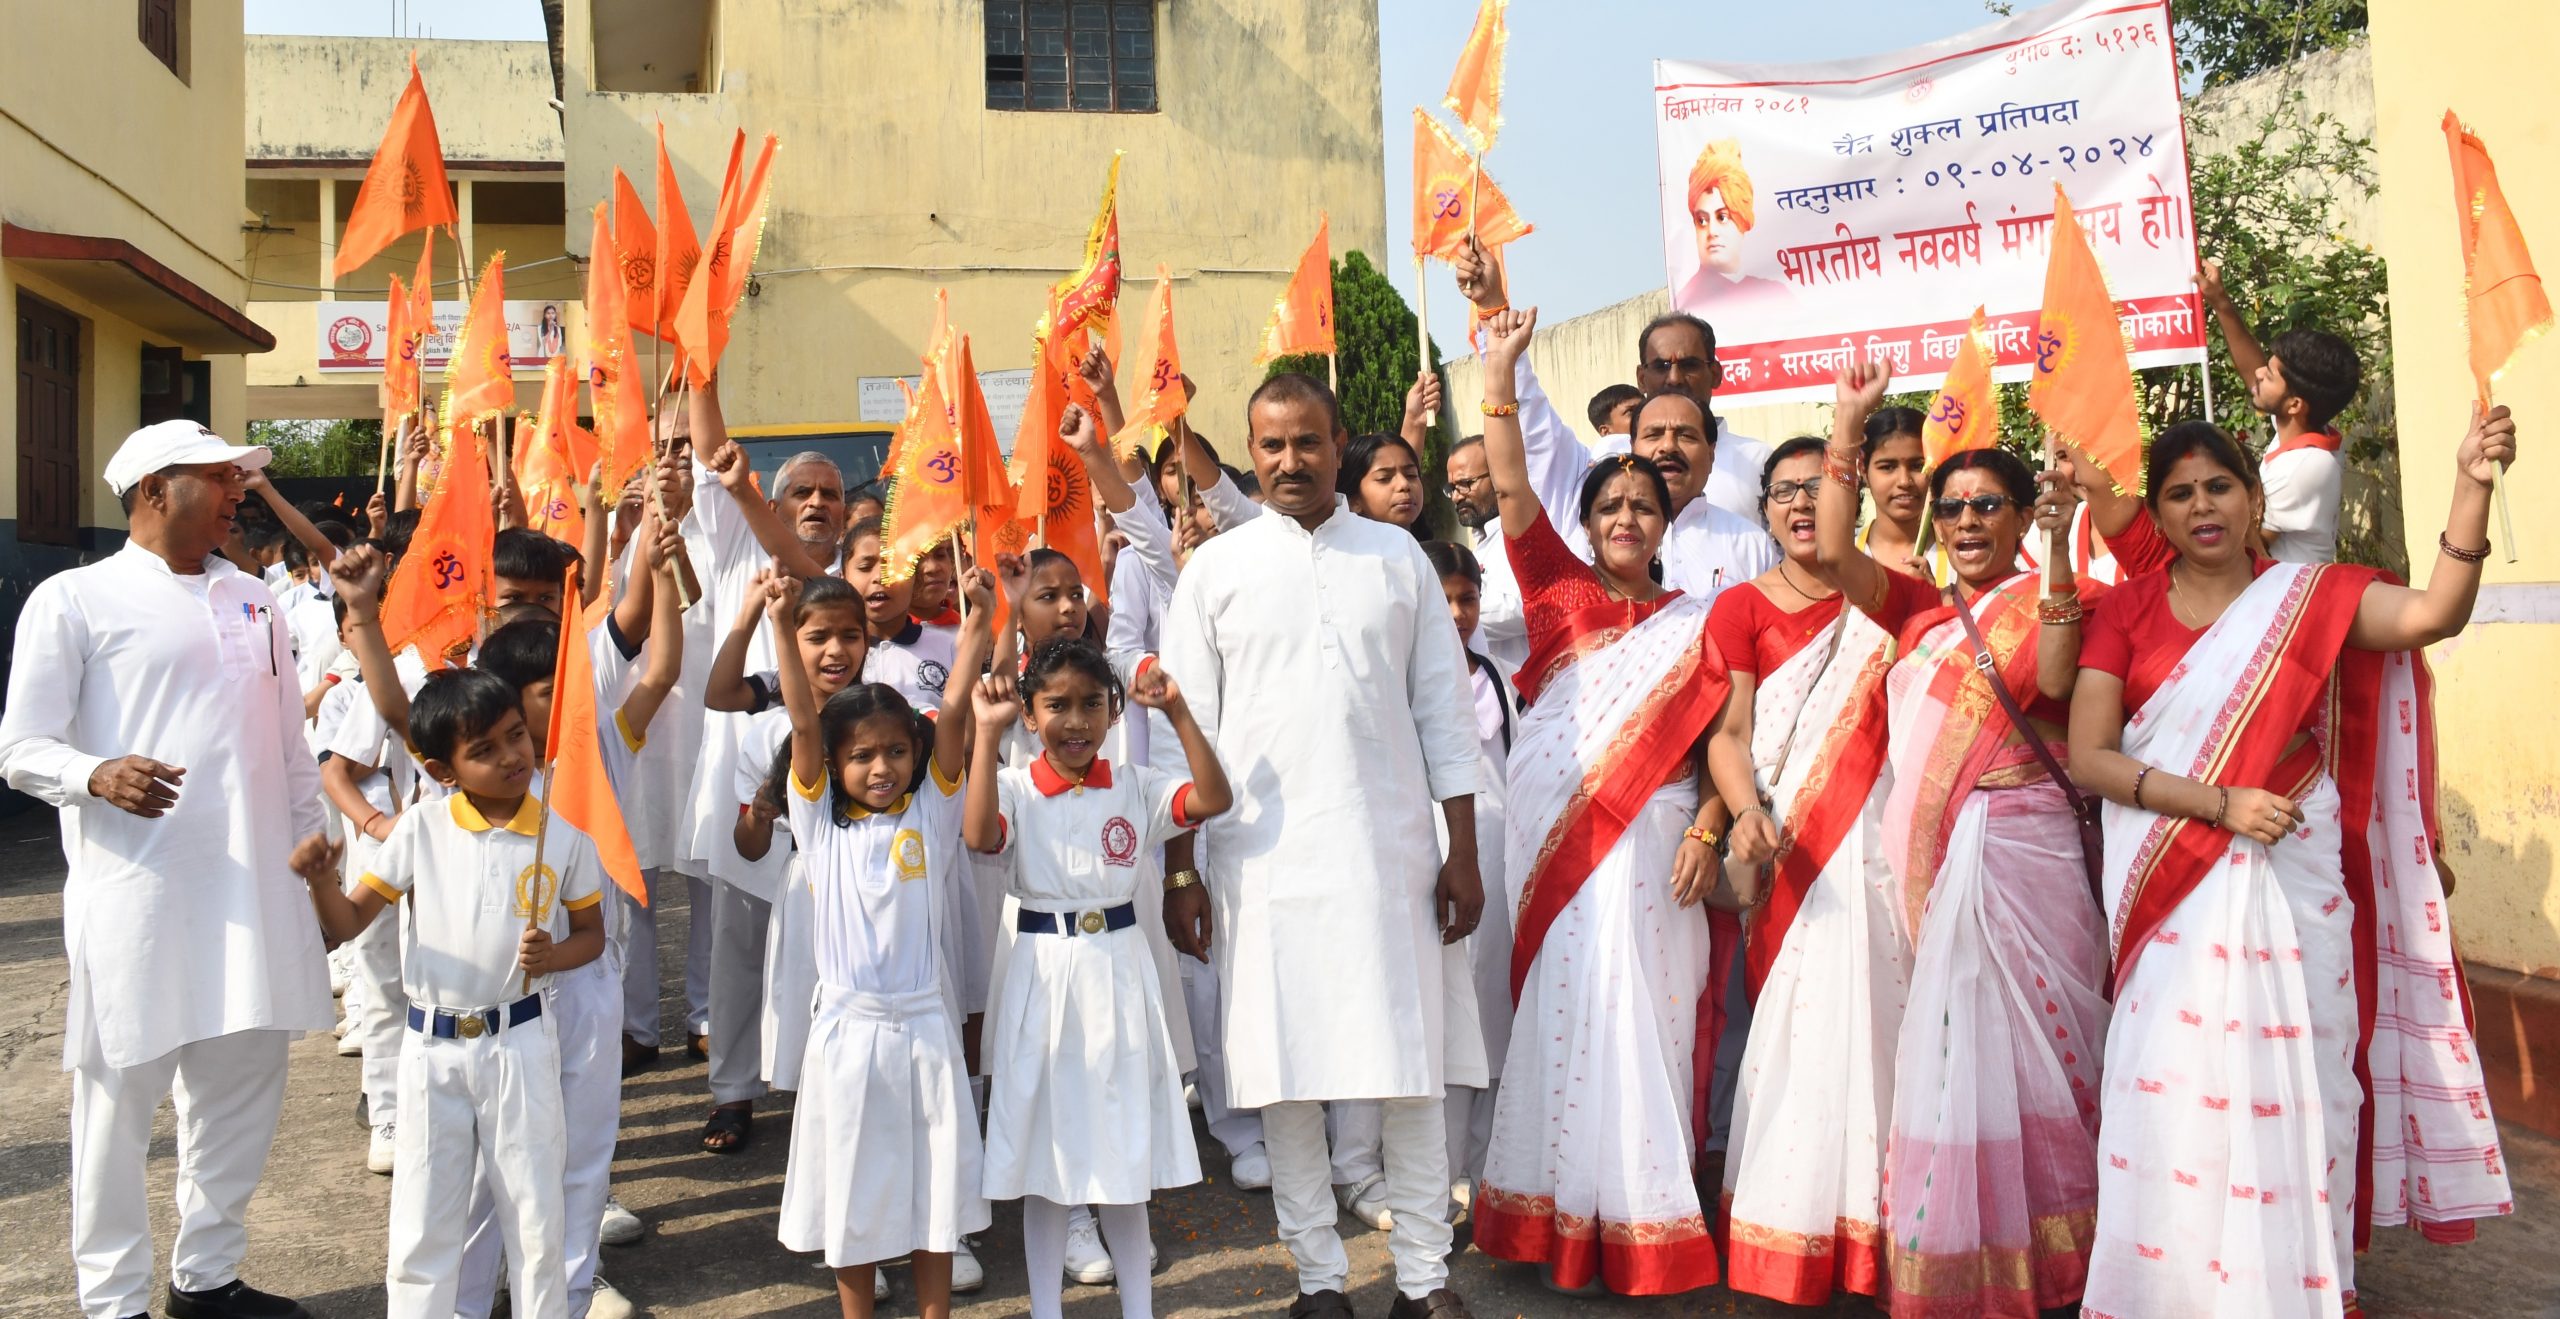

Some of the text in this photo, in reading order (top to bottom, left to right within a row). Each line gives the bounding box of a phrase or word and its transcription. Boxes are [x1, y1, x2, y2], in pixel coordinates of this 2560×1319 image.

[1755, 96, 1809, 114] २०८१
[1976, 99, 2080, 137] प्रतिपदा
[1774, 178, 1879, 214] तदनुसार
[1776, 222, 1882, 287] भारतीय
[1893, 201, 1983, 273] नववर्ष
[1780, 338, 1856, 376] सरस्वती
[1864, 335, 1912, 374] शिशु
